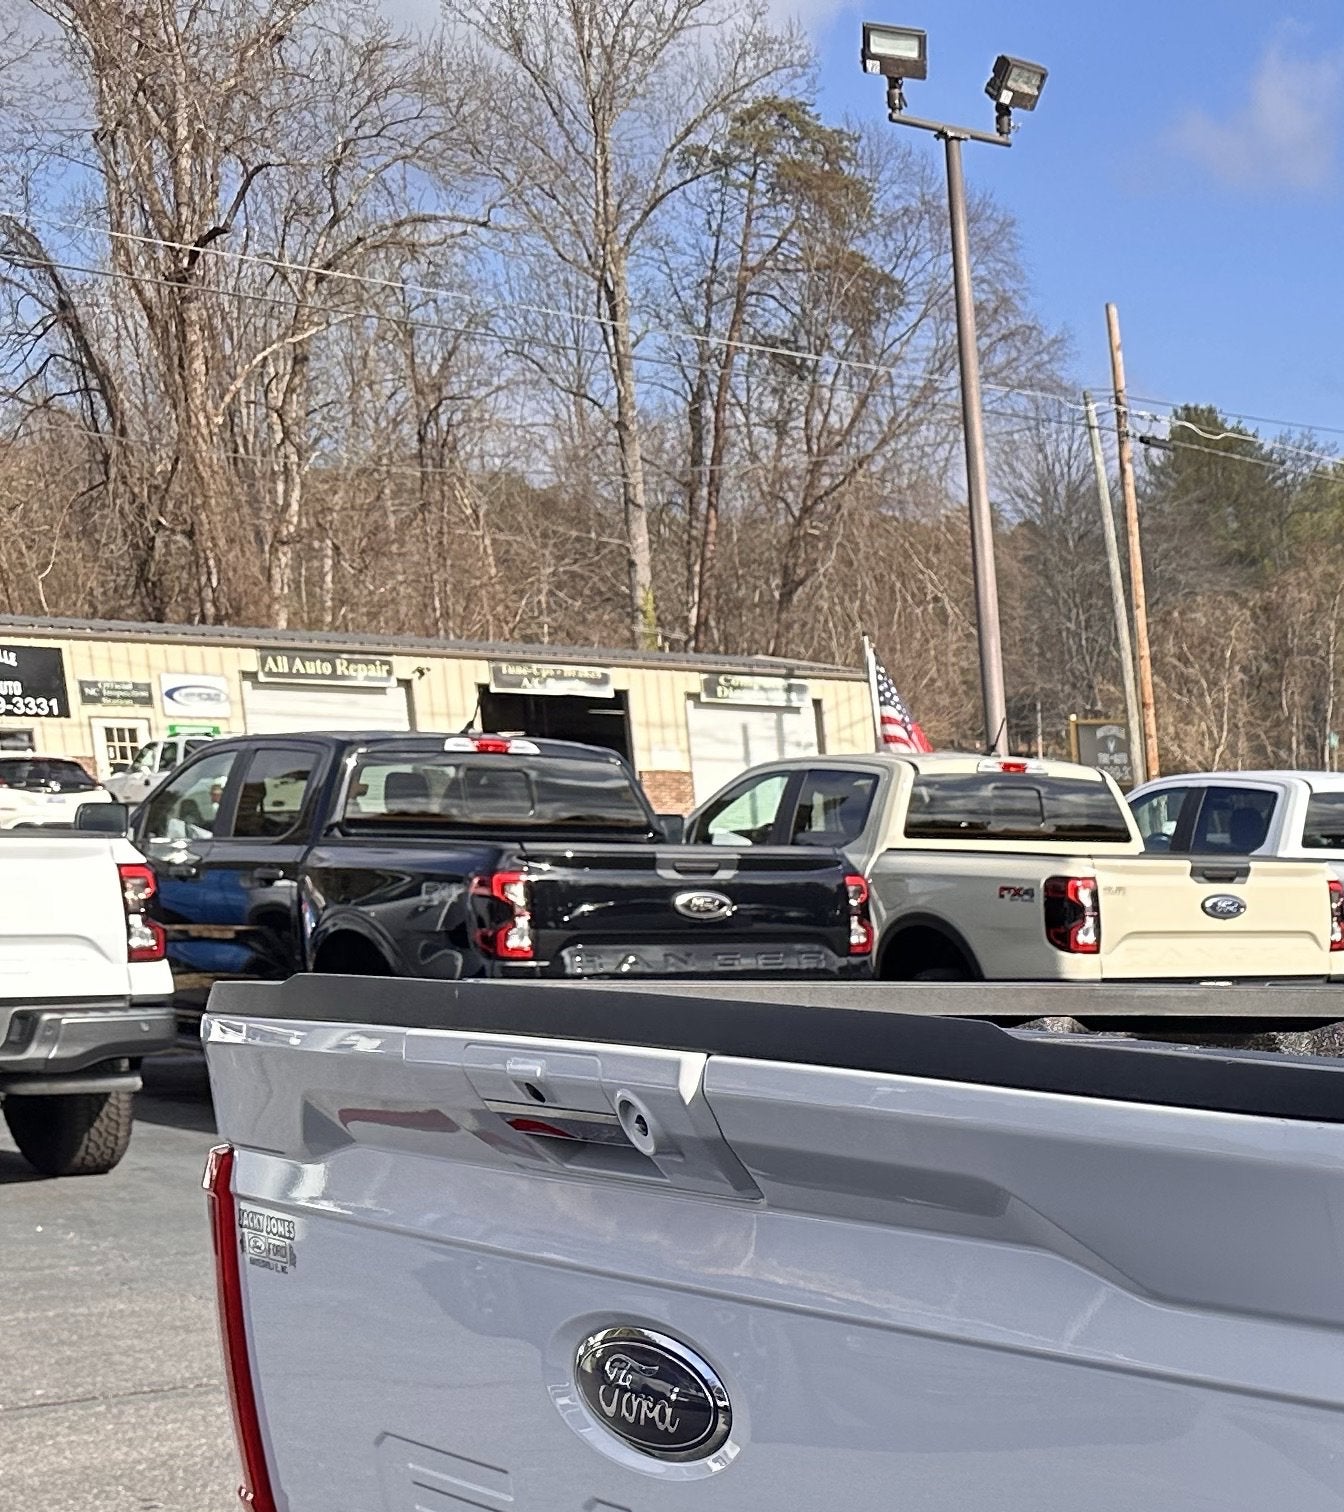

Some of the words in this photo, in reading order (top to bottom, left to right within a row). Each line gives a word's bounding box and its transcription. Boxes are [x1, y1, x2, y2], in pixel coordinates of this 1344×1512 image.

[264, 655, 289, 673] All
[292, 656, 332, 675] Auto
[335, 658, 390, 681] Repair
[265, 1214, 296, 1241] JONES
